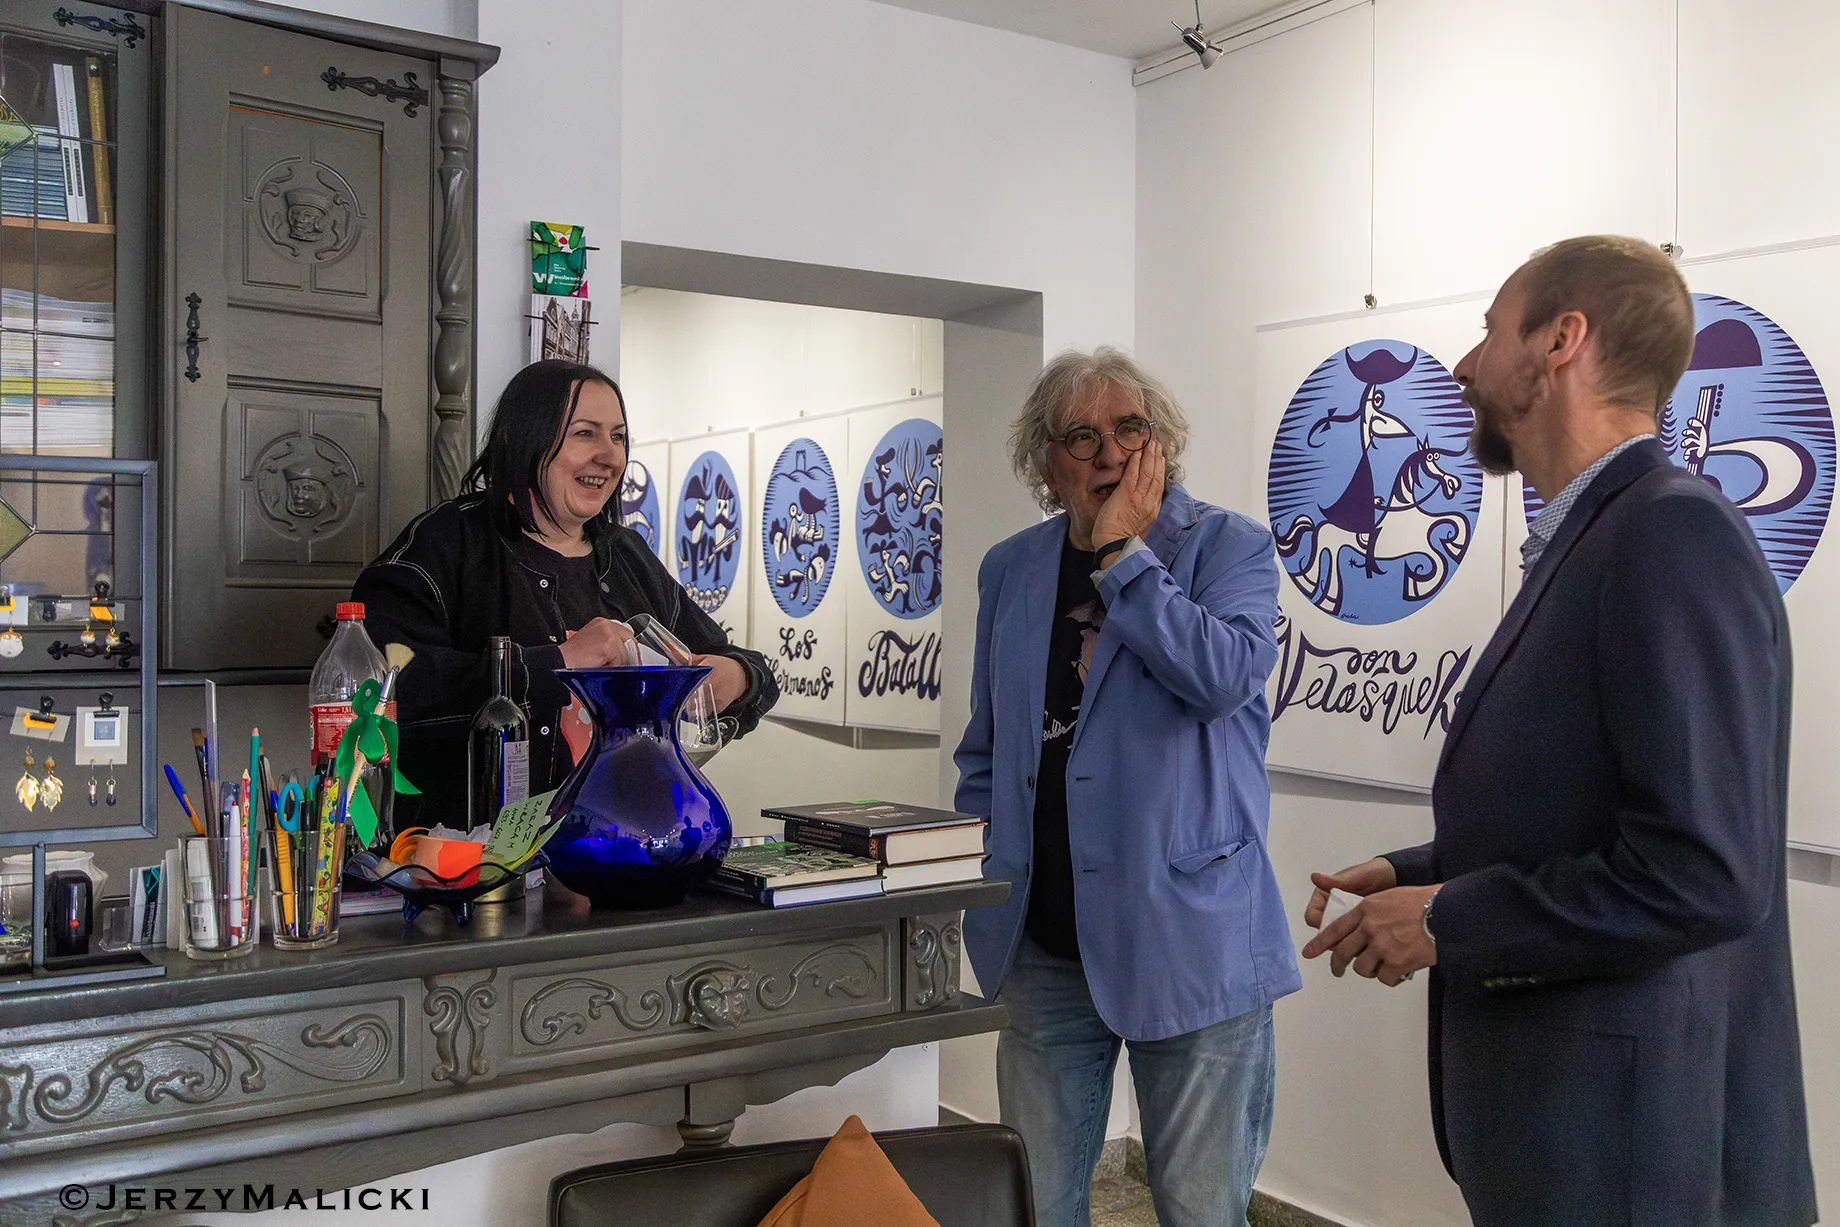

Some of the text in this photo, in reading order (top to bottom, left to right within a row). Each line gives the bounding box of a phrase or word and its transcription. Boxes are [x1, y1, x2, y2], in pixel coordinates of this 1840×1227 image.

[779, 626, 818, 661] Los
[858, 629, 942, 700] Batall
[1347, 649, 1418, 676] don
